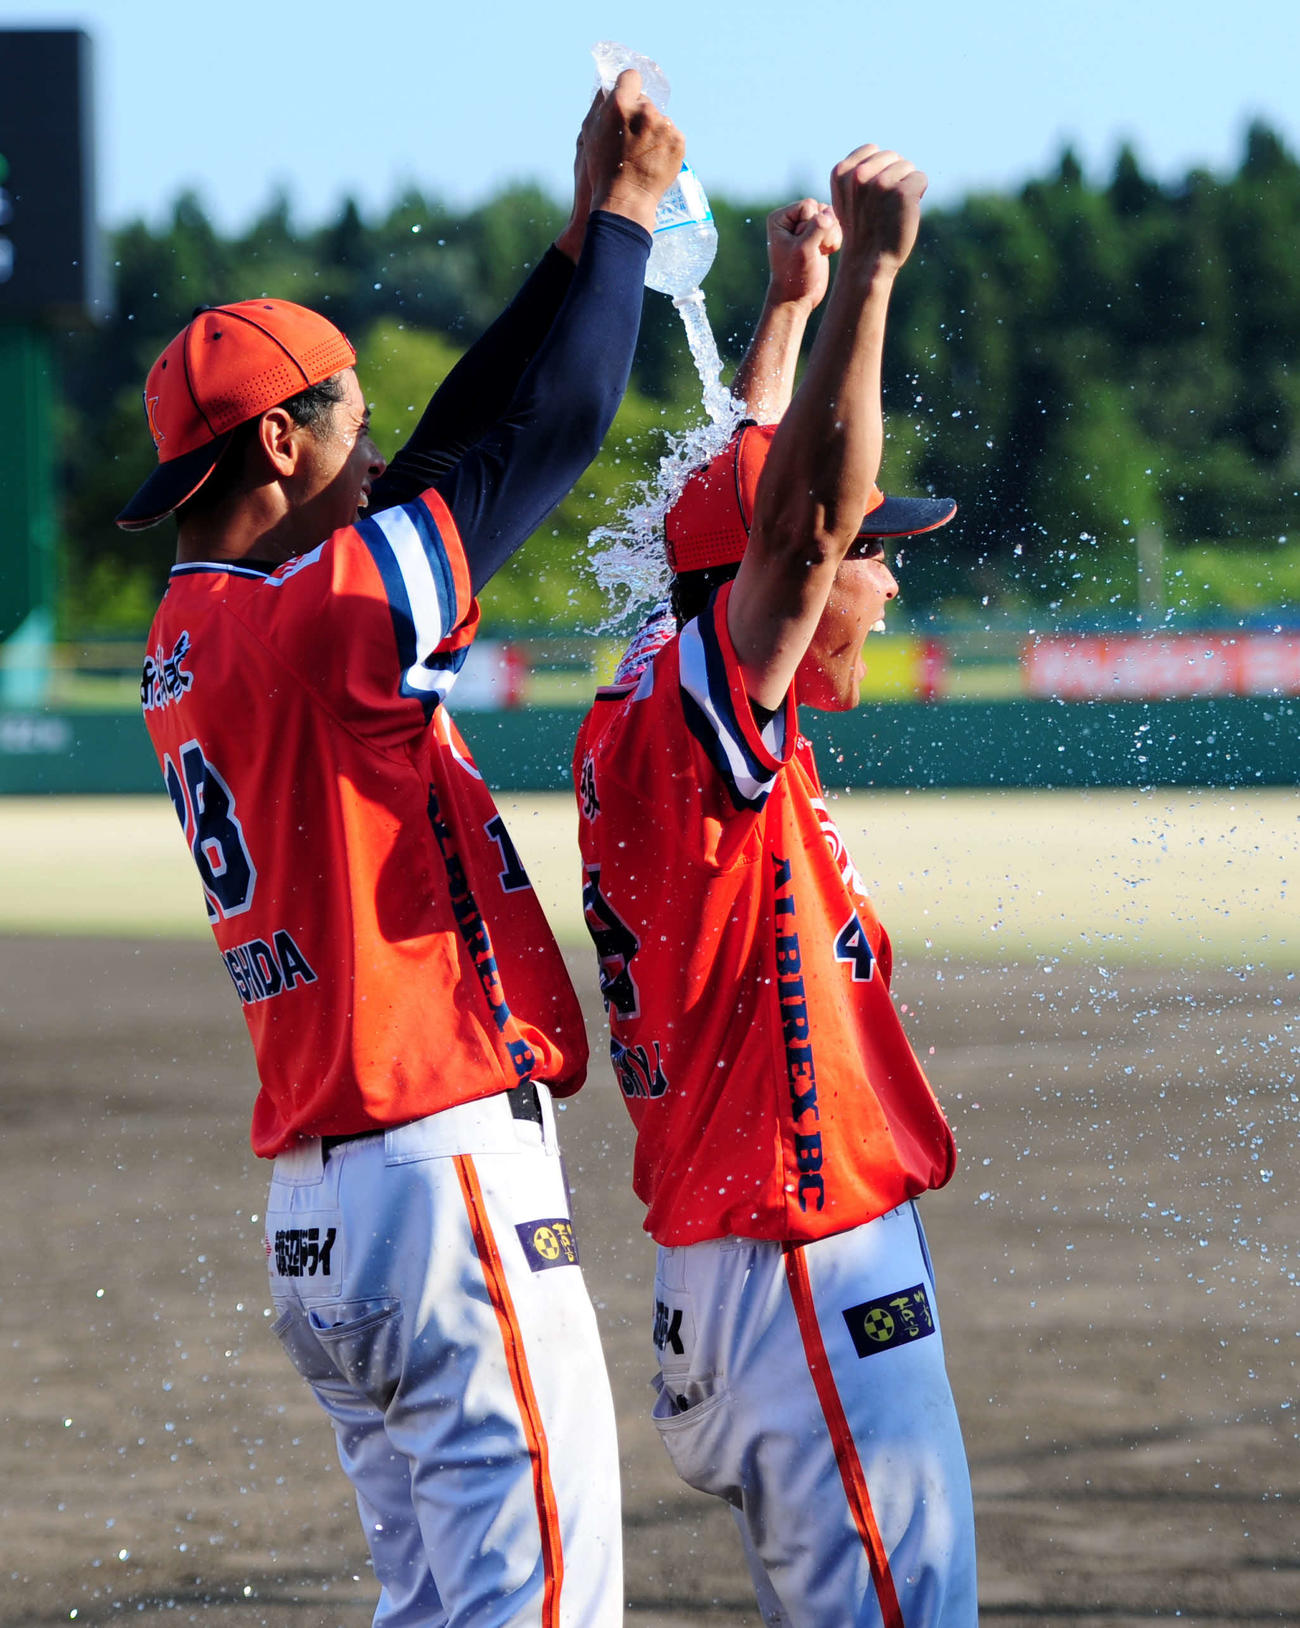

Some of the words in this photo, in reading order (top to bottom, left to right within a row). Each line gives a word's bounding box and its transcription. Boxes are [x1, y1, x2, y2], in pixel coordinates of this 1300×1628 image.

[220, 928, 319, 1007] SHIDA
[771, 851, 820, 1123] ALBIREX
[505, 1038, 536, 1088] B
[794, 1130, 825, 1212] BC
